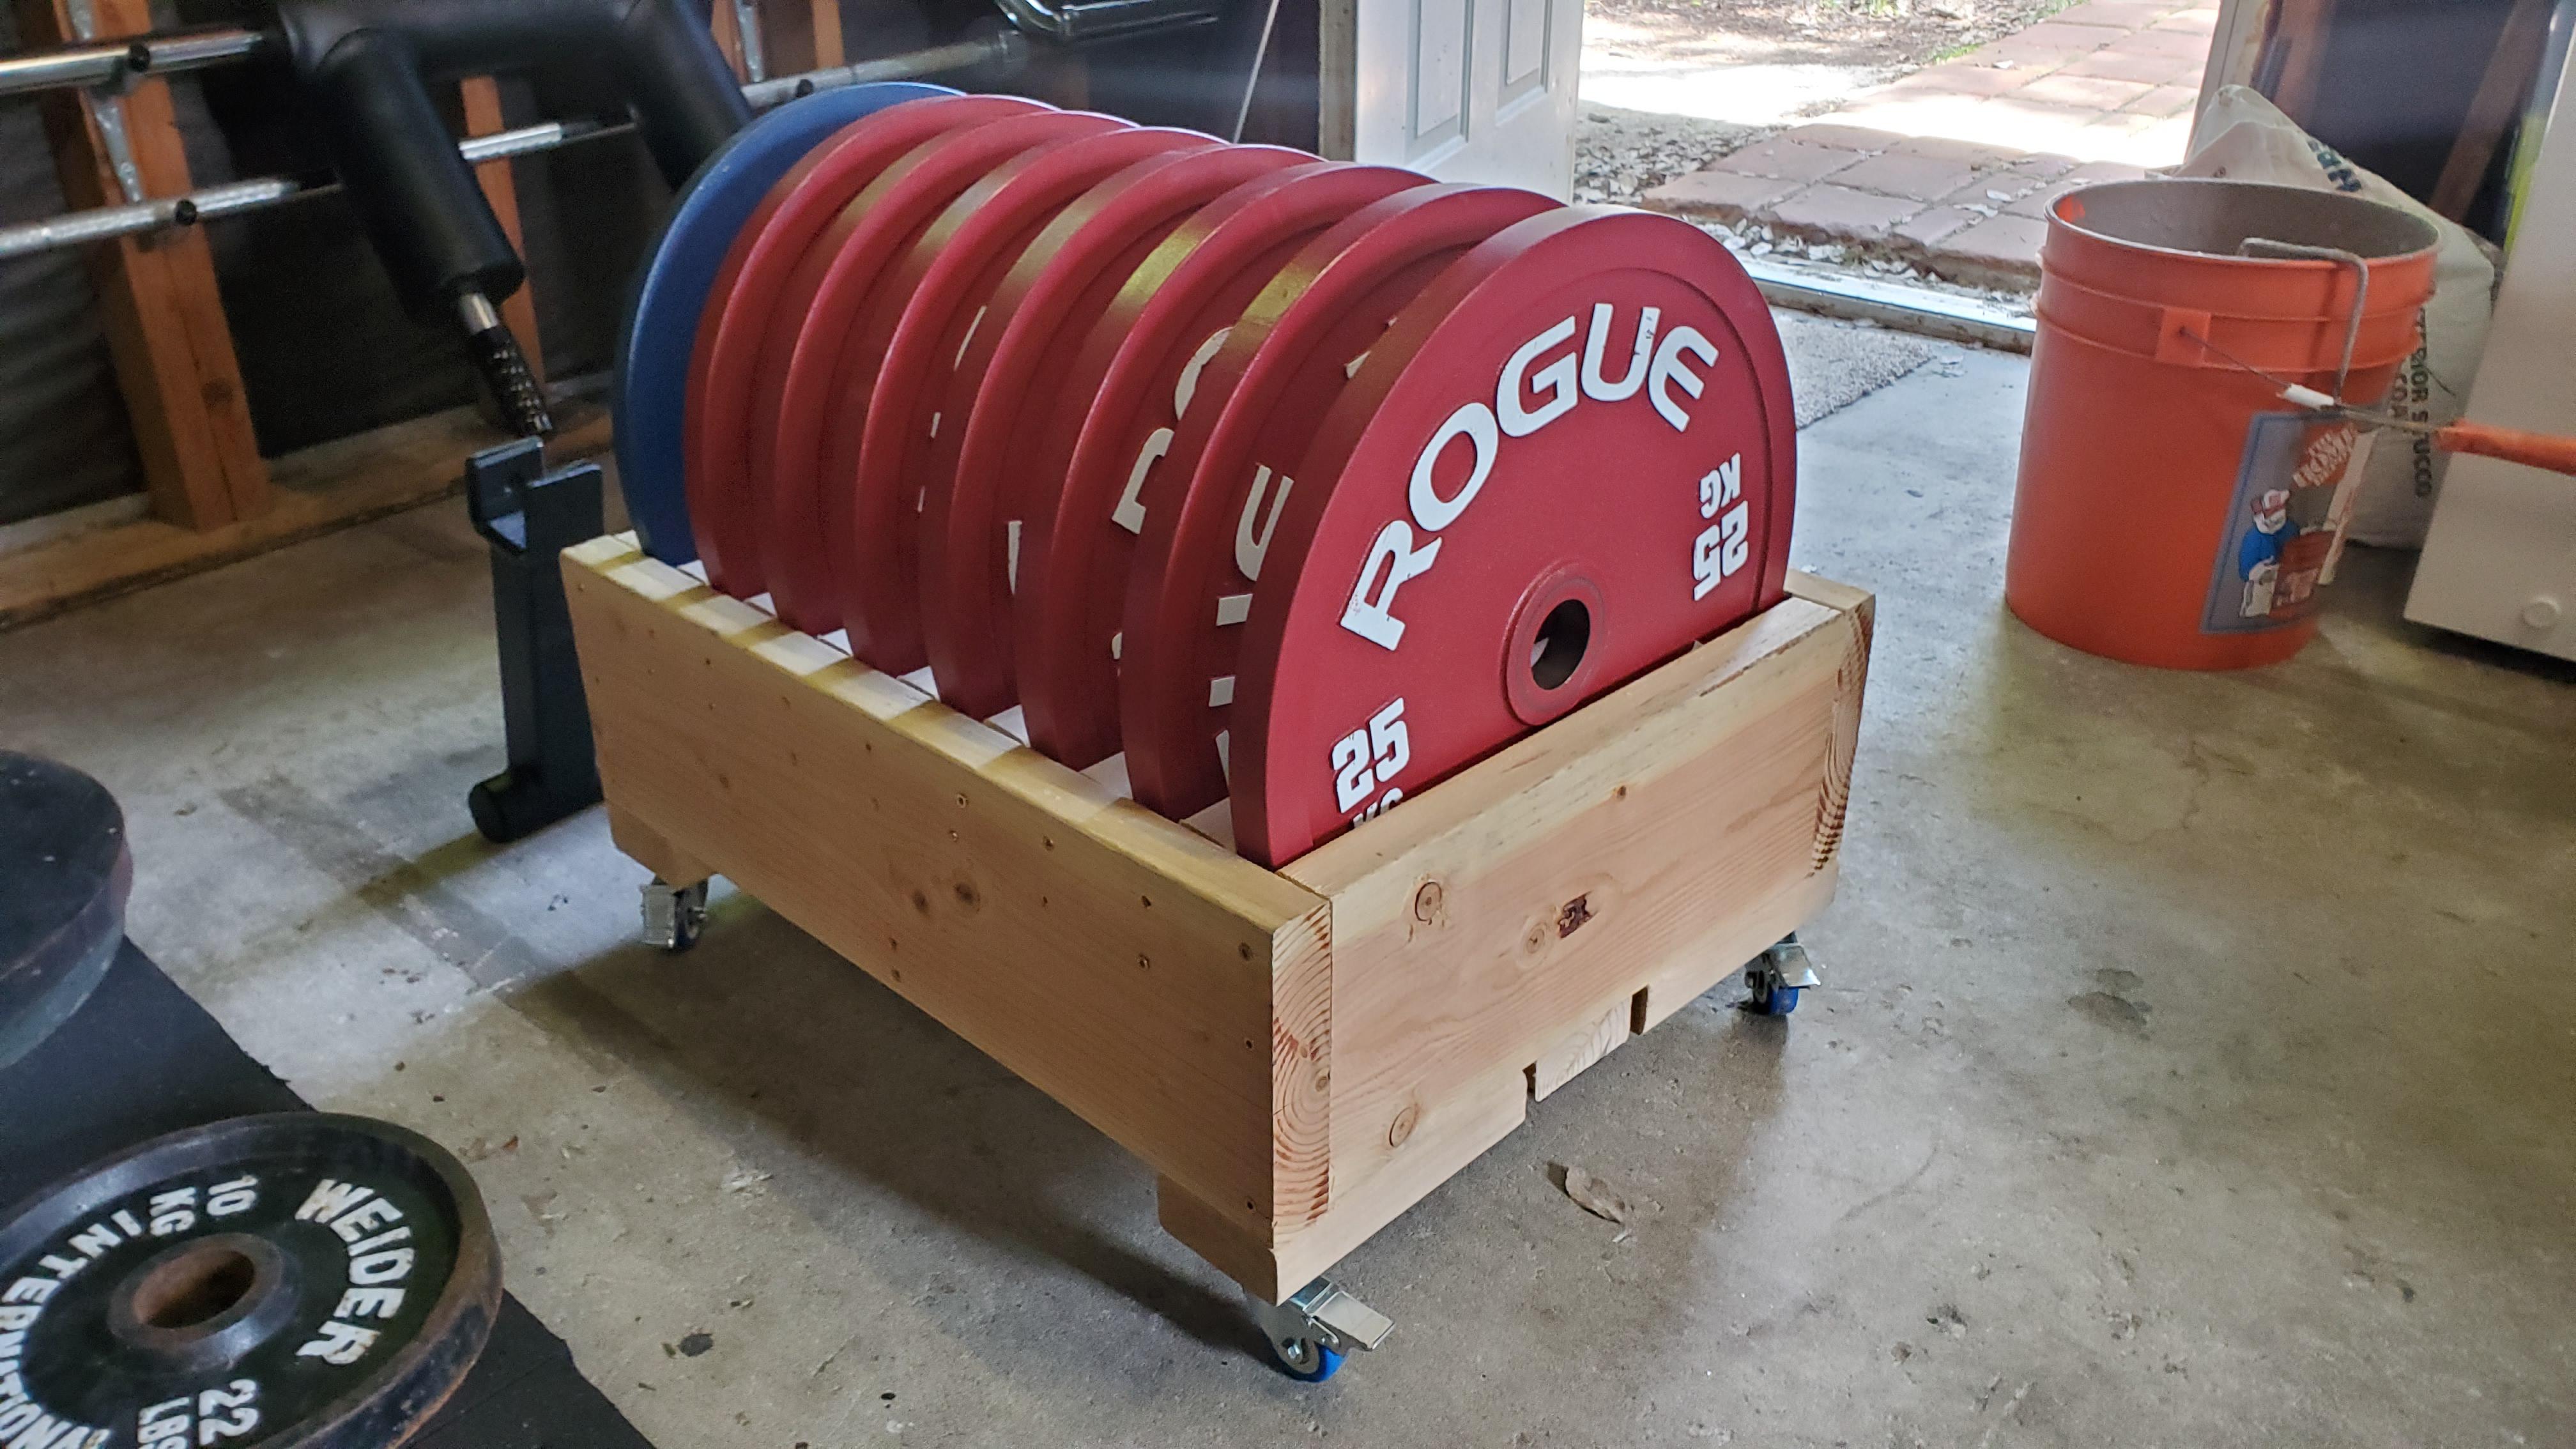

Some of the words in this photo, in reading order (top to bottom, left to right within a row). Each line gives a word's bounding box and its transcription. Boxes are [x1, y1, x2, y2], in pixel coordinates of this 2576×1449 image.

[1340, 303, 1719, 651] ROGUE
[1699, 452, 1741, 519] KG
[1694, 500, 1749, 601] 25
[1332, 697, 1410, 813] 25
[150, 1186, 196, 1236] KG
[206, 1175, 258, 1216] 10
[294, 1179, 415, 1365] WEIDER
[199, 1378, 259, 1446] 22
